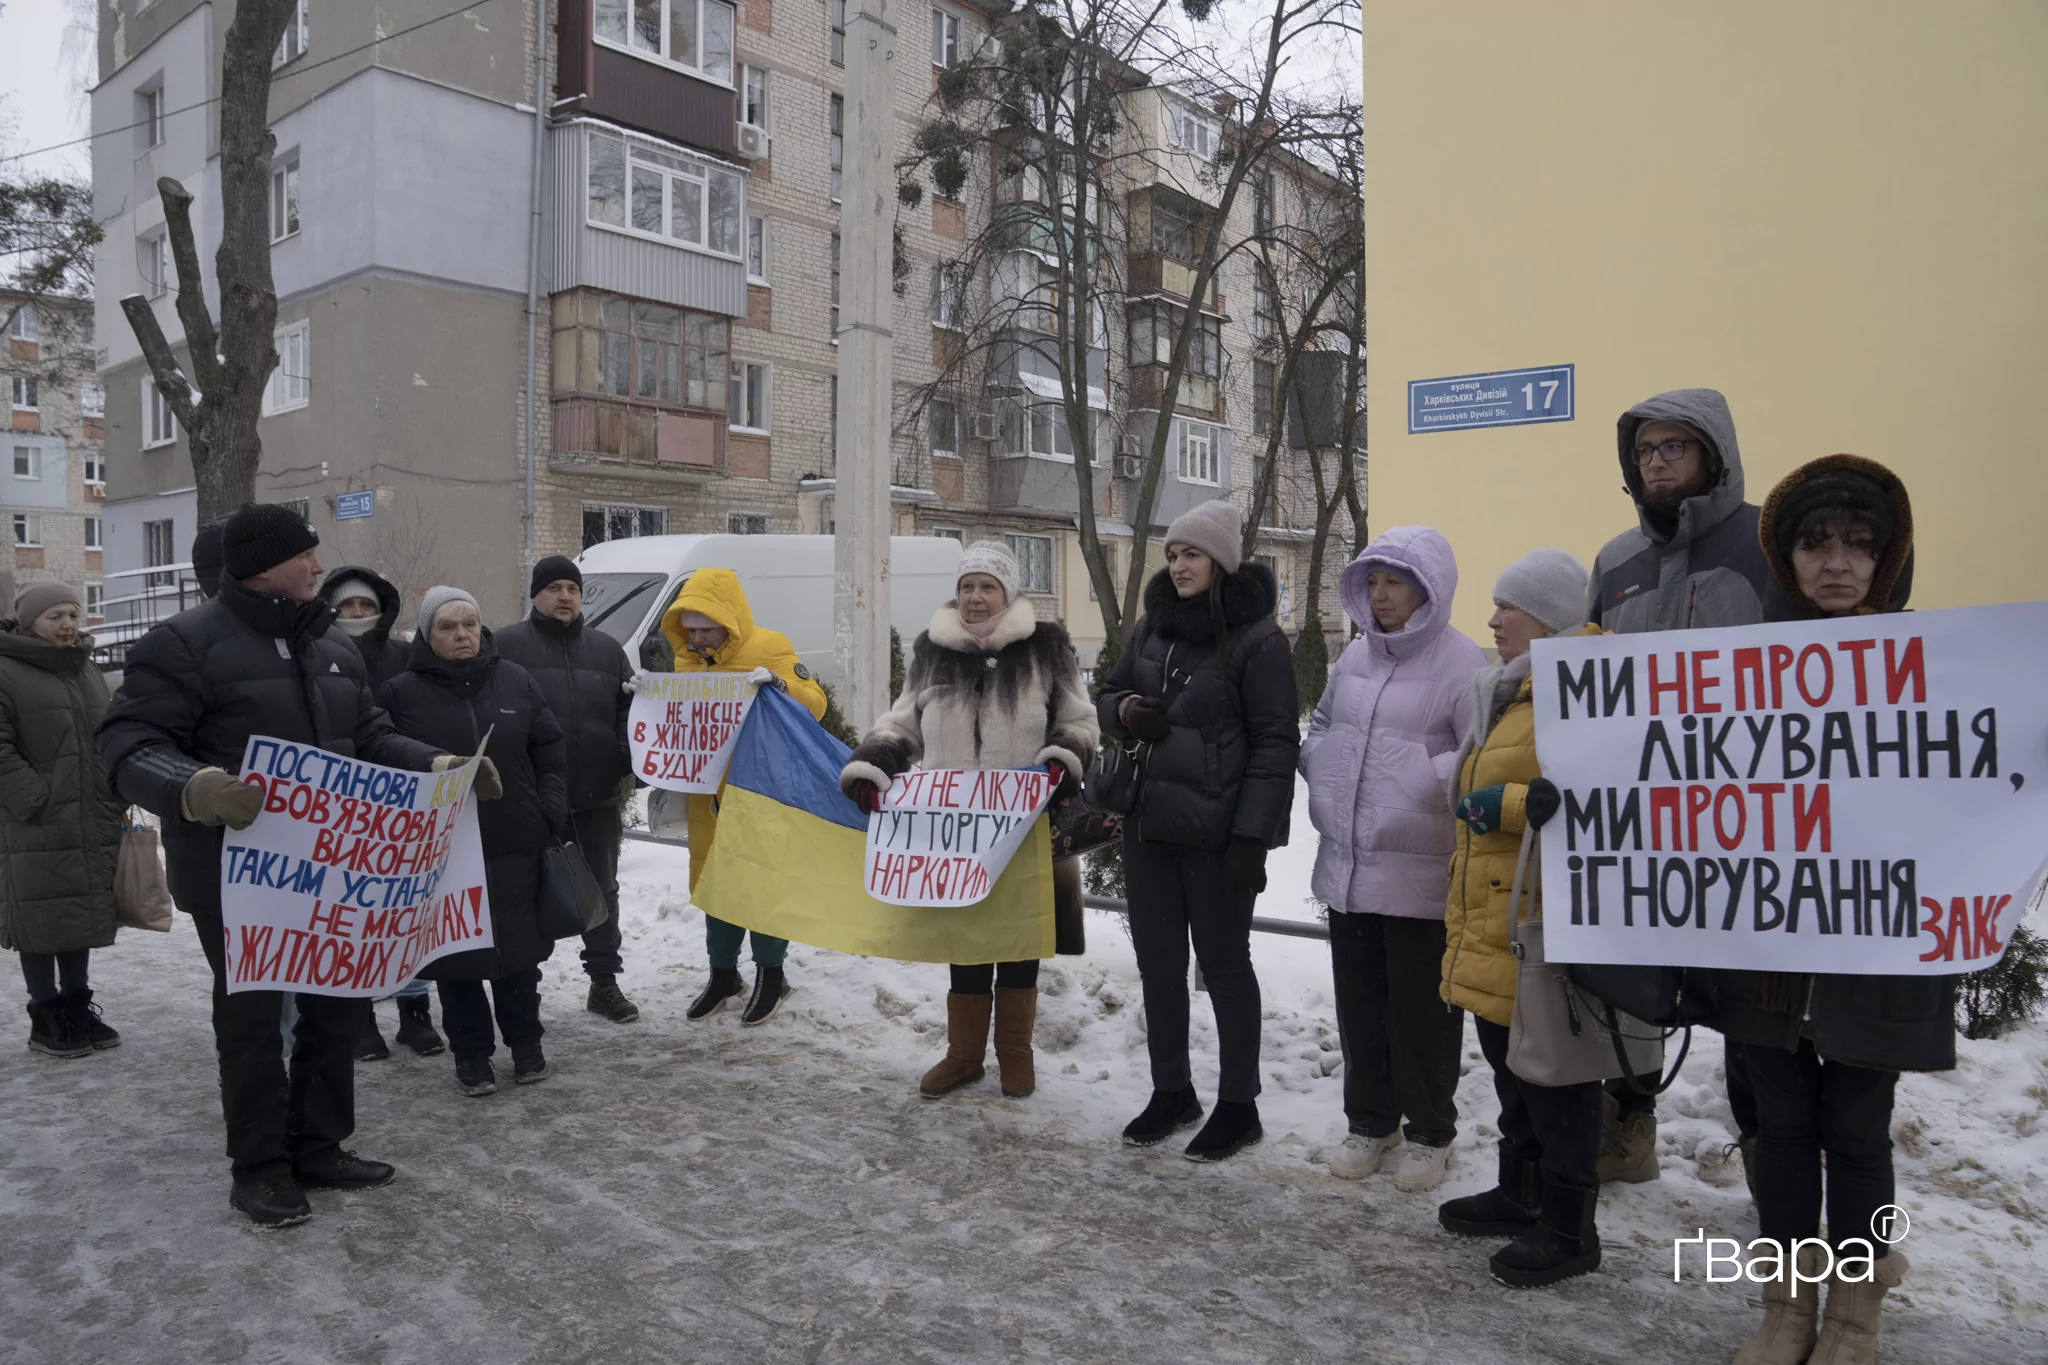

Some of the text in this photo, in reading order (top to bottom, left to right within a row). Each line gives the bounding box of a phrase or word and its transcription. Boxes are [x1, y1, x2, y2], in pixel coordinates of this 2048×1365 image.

[1424, 387, 1507, 407] Харківських Дивізій
[1451, 382, 1480, 392] вулиця
[1521, 380, 1559, 411] 17
[1423, 411, 1468, 423] Kharkivskykh
[1495, 408, 1509, 417] Str.
[360, 496, 370, 511] 15
[1557, 636, 1927, 720] МИ НЕ ПРОТИ
[665, 702, 683, 724] НЕ
[633, 722, 736, 752] В ЖИТЛОВИ
[248, 740, 419, 809] ПОСТАНОВА
[642, 750, 713, 784] БУДИ
[928, 770, 964, 808] НЕ
[968, 771, 1051, 812] ЛІКУЮТ
[874, 810, 918, 850] ТУТ
[1563, 783, 1832, 853] МИ ПРОТИ
[226, 845, 450, 908] ТАКИМ УСТАНО
[870, 851, 990, 900] НАРКОТИ
[308, 900, 357, 938] НЕ
[235, 925, 396, 990] ЖИТЛОВИХ
